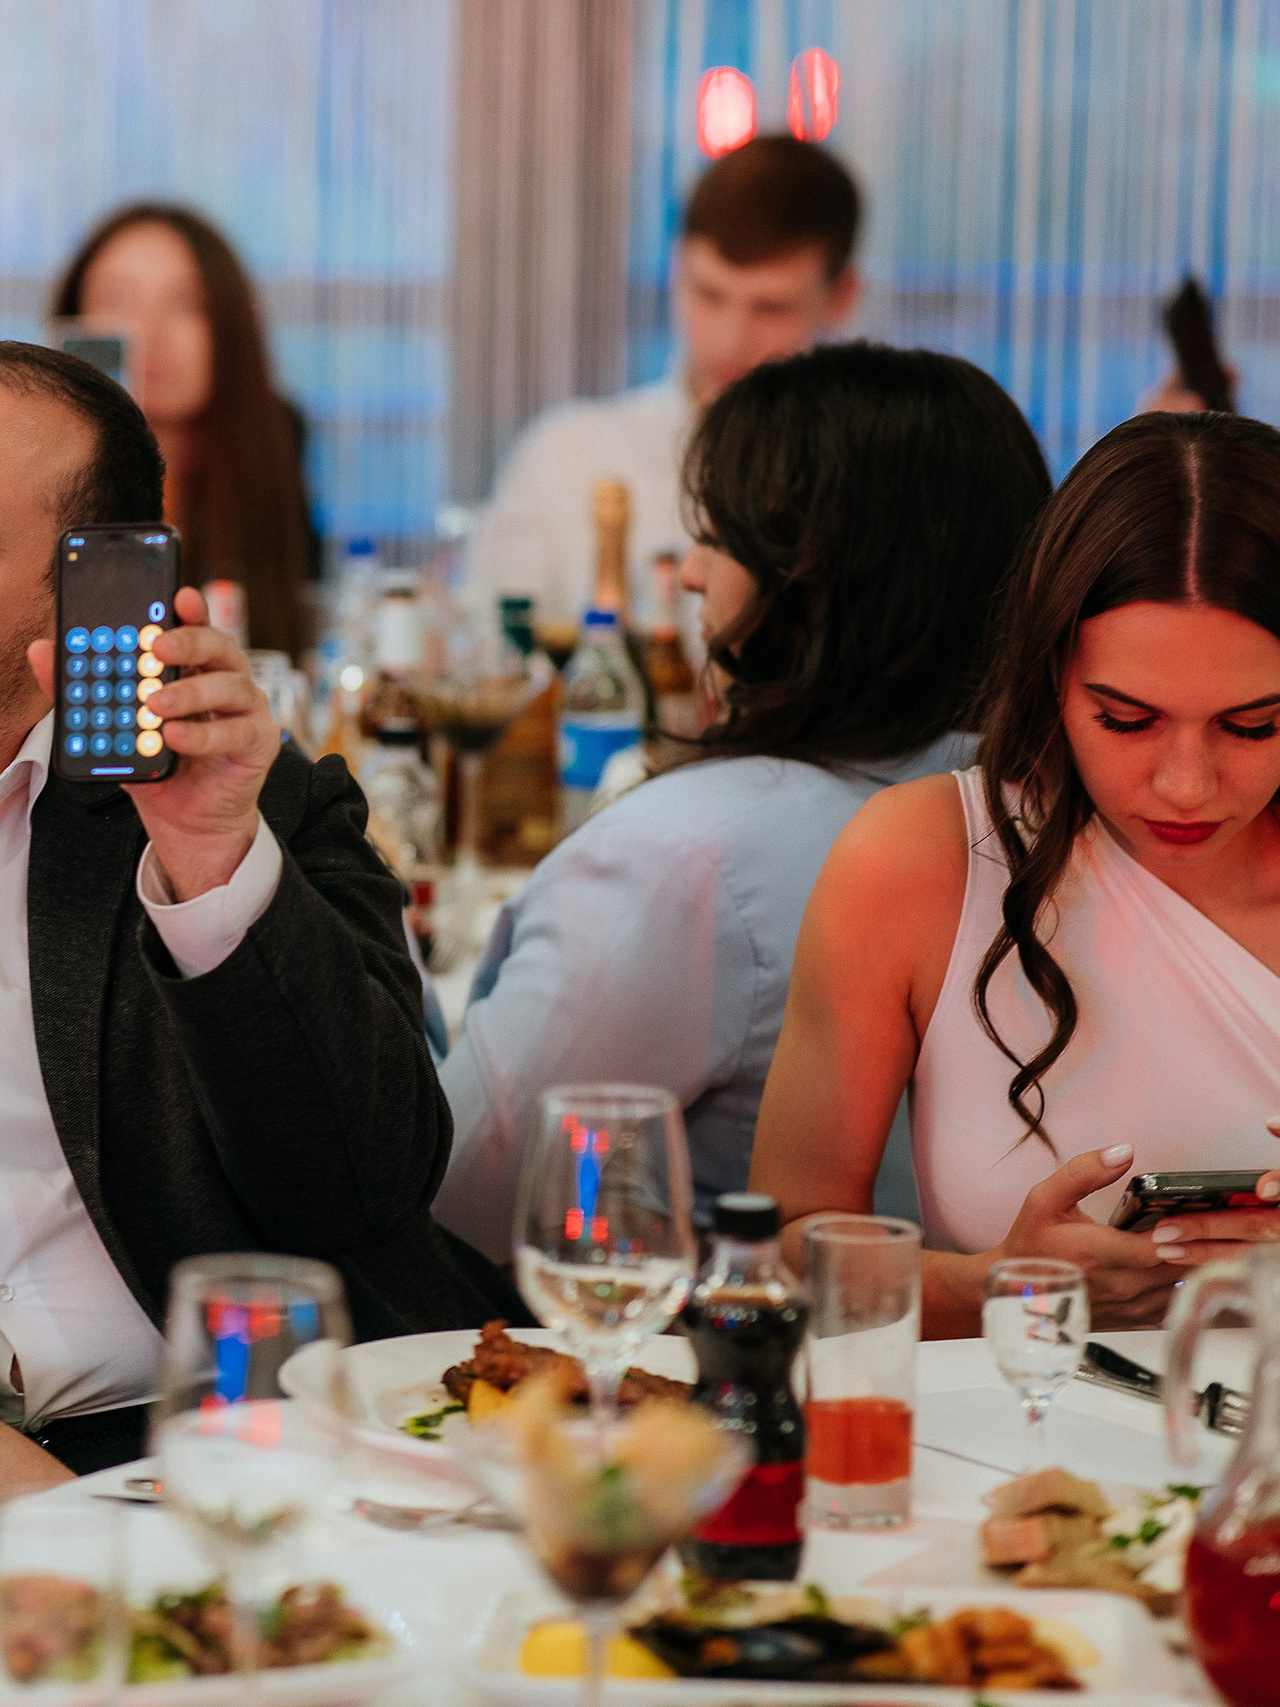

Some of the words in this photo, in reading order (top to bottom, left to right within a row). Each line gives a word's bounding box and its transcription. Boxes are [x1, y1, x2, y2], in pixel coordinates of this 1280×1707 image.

[148, 601, 166, 622] 0
[73, 660, 83, 672] 7
[96, 712, 107, 724] 2
[121, 711, 131, 724] 3
